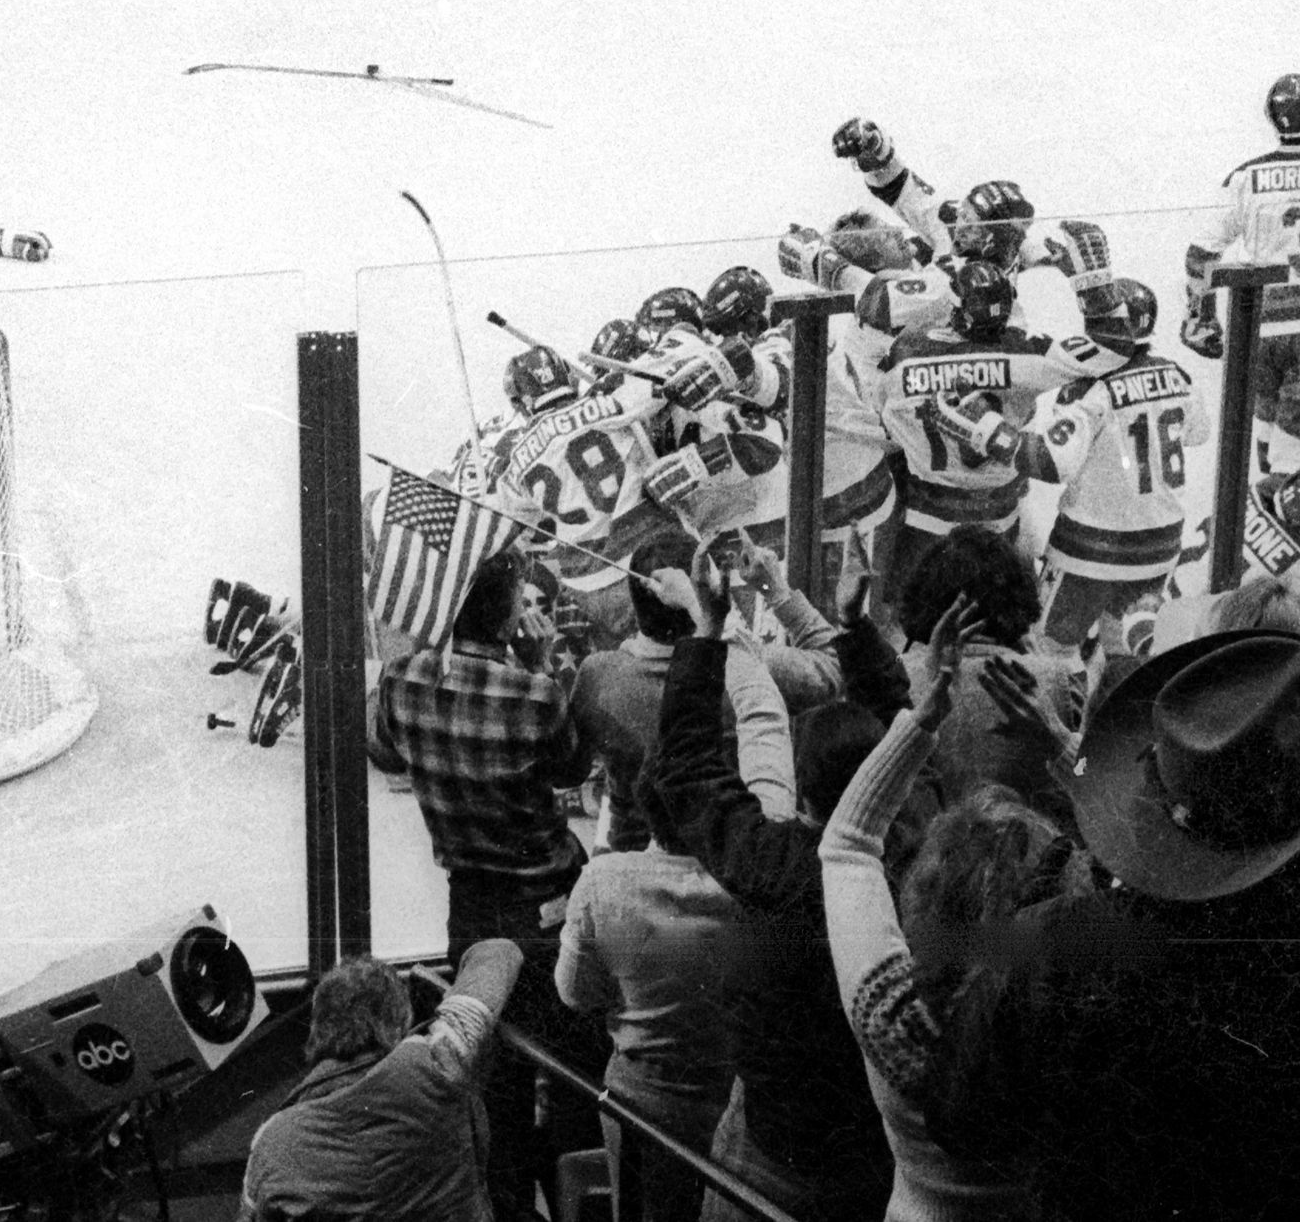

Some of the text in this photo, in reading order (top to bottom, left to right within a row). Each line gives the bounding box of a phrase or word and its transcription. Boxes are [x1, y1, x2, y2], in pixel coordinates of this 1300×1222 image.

[905, 360, 1008, 395] JOHNSON
[522, 428, 628, 526] 28
[1127, 406, 1187, 495] 16
[77, 1039, 130, 1070] abc
